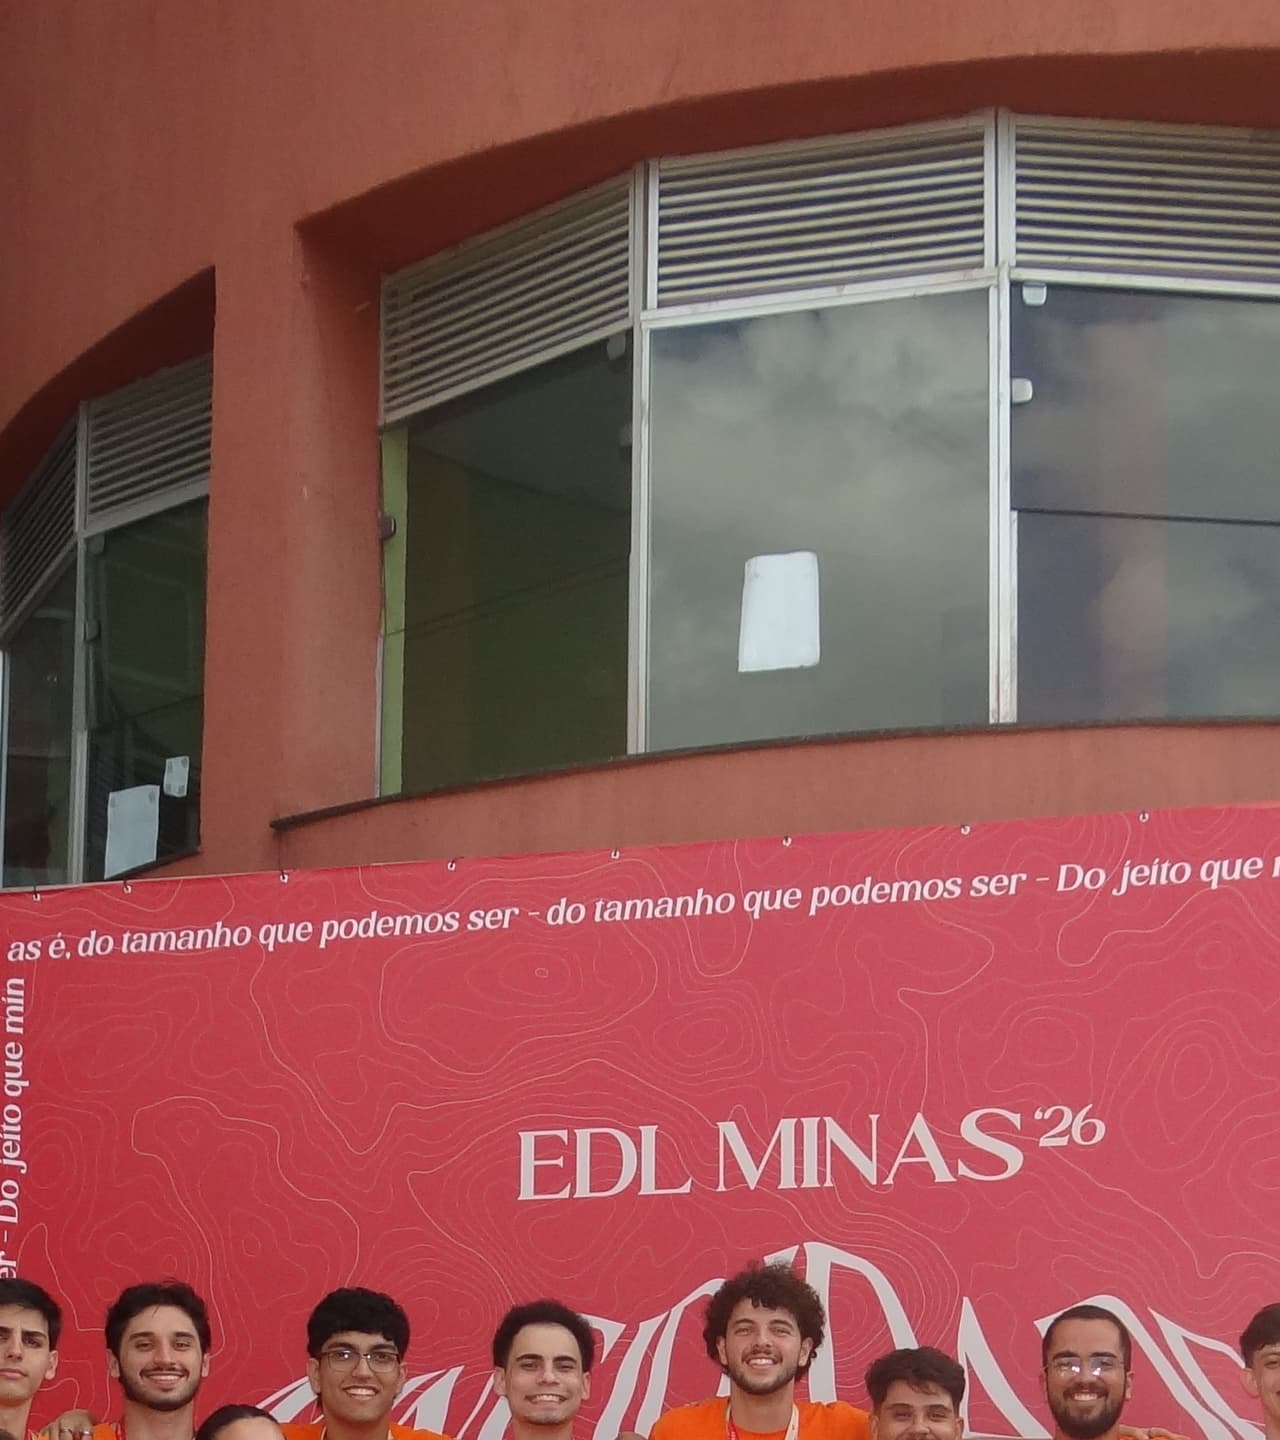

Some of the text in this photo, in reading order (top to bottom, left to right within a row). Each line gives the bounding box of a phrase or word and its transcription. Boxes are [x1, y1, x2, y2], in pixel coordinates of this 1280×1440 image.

[7, 937, 41, 962] as
[48, 932, 71, 960] é,
[77, 929, 114, 957] do
[121, 921, 252, 954] tamanho
[258, 920, 313, 952] que
[319, 910, 461, 949] podemos
[466, 905, 519, 931] ser
[546, 896, 586, 926] do
[593, 887, 736, 923] tamanho
[742, 886, 802, 920] que
[808, 876, 962, 916] podemos
[969, 872, 1027, 898] ser
[1056, 862, 1107, 892] Do
[1111, 856, 1192, 896] jeito
[1199, 855, 1264, 890] que
[1, 977, 26, 1035] min
[2, 1040, 30, 1098] que
[517, 1123, 692, 1201] EDL
[715, 1107, 1024, 1192] MINAS
